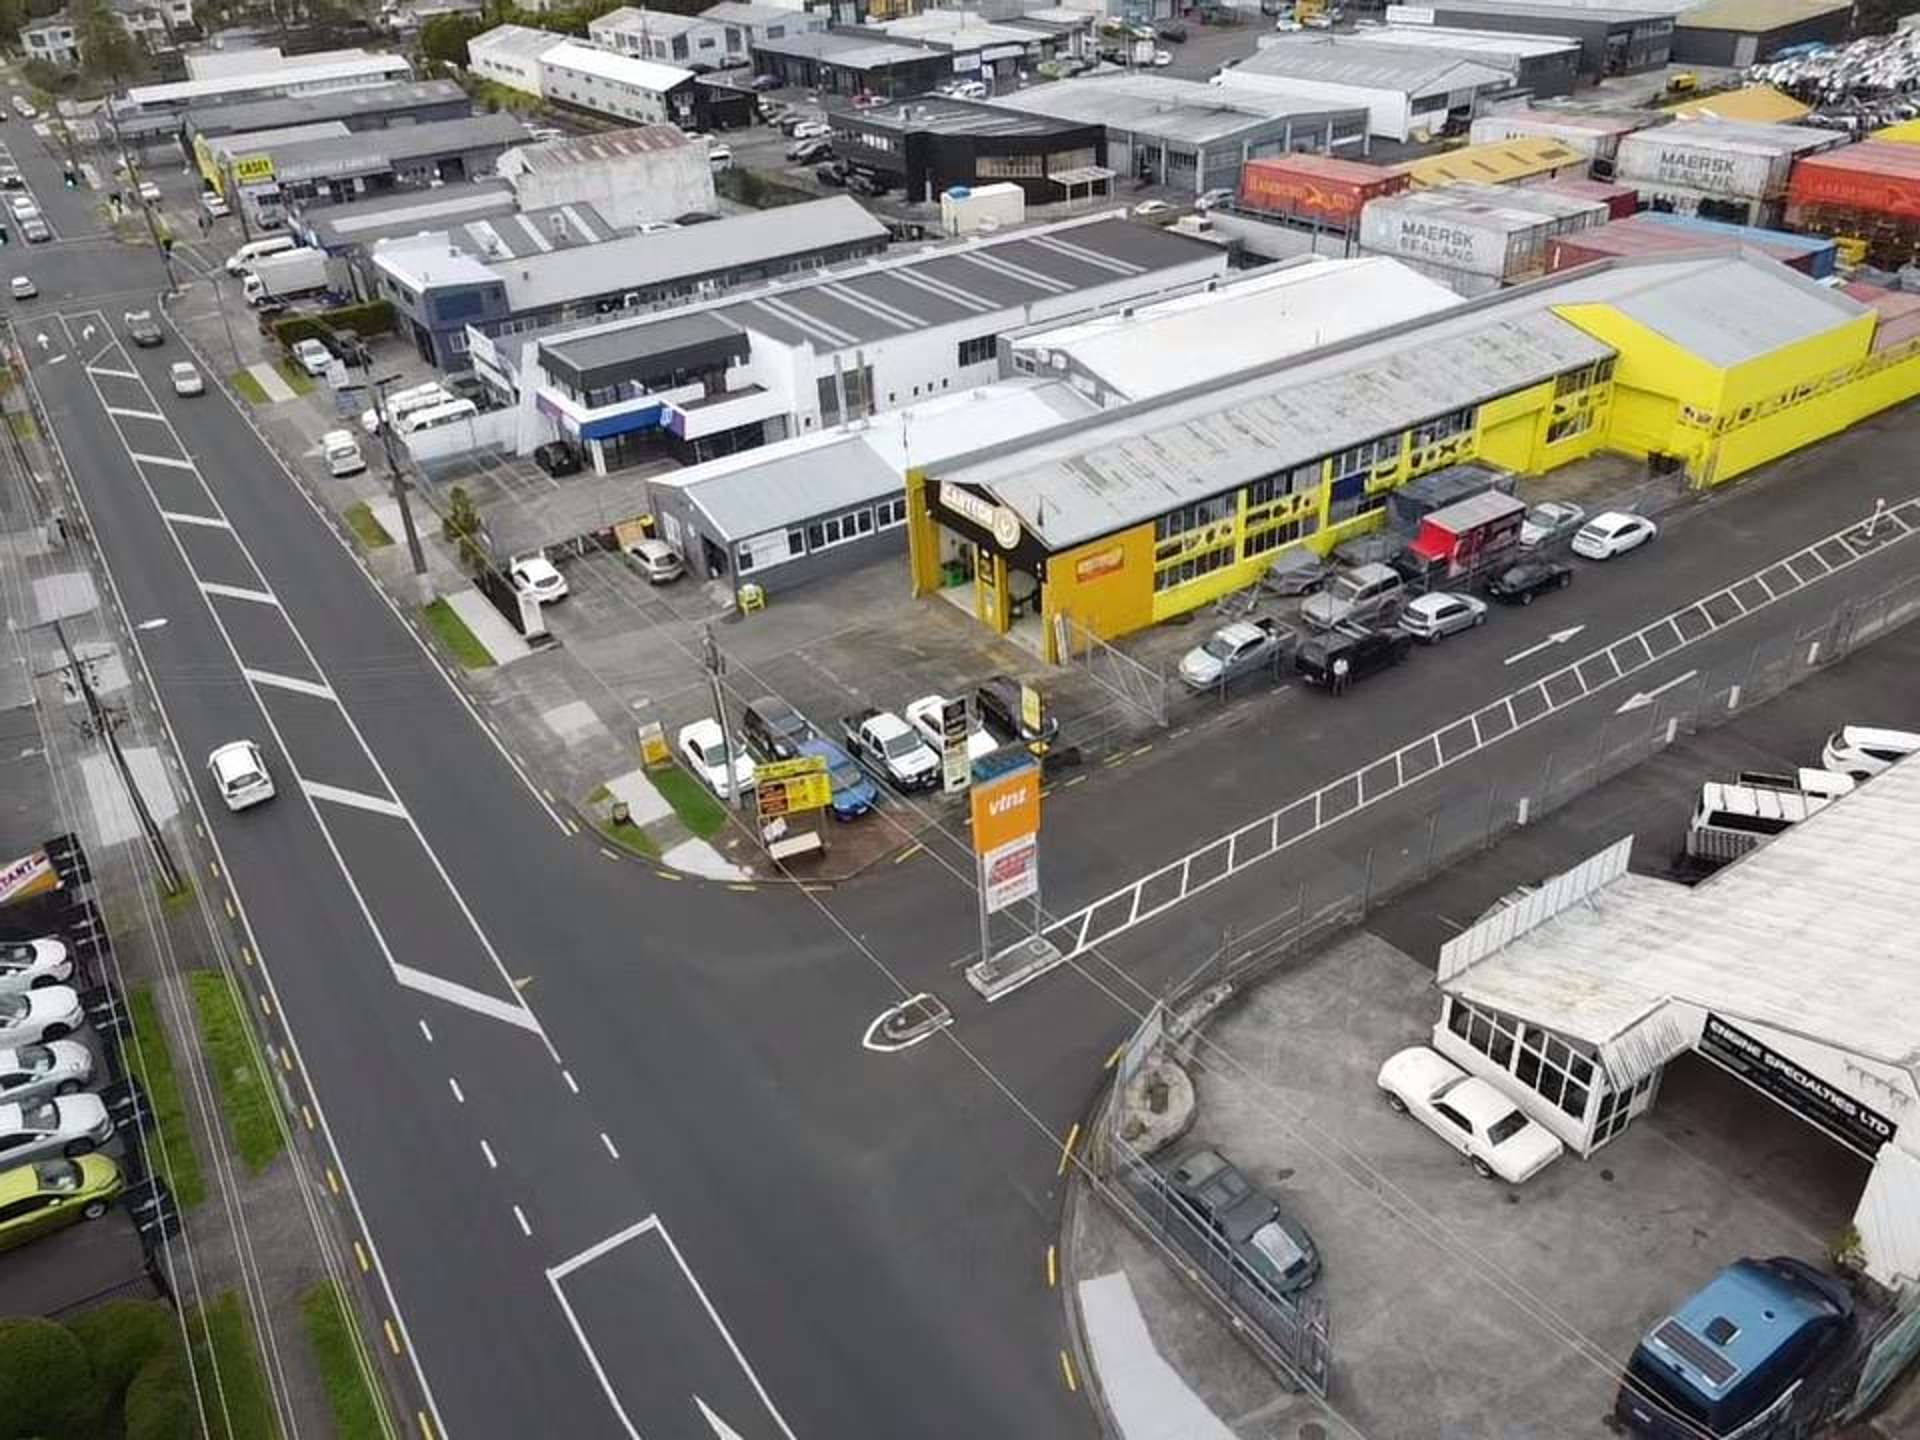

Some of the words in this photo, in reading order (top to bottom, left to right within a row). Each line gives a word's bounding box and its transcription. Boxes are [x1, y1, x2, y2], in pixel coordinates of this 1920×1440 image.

[1661, 150, 1736, 174] MAERSK
[1401, 220, 1473, 248] MAERSK
[0, 860, 33, 893] TANT
[1709, 1020, 1762, 1057] ENGINE
[1860, 1110, 1891, 1137] LTD
